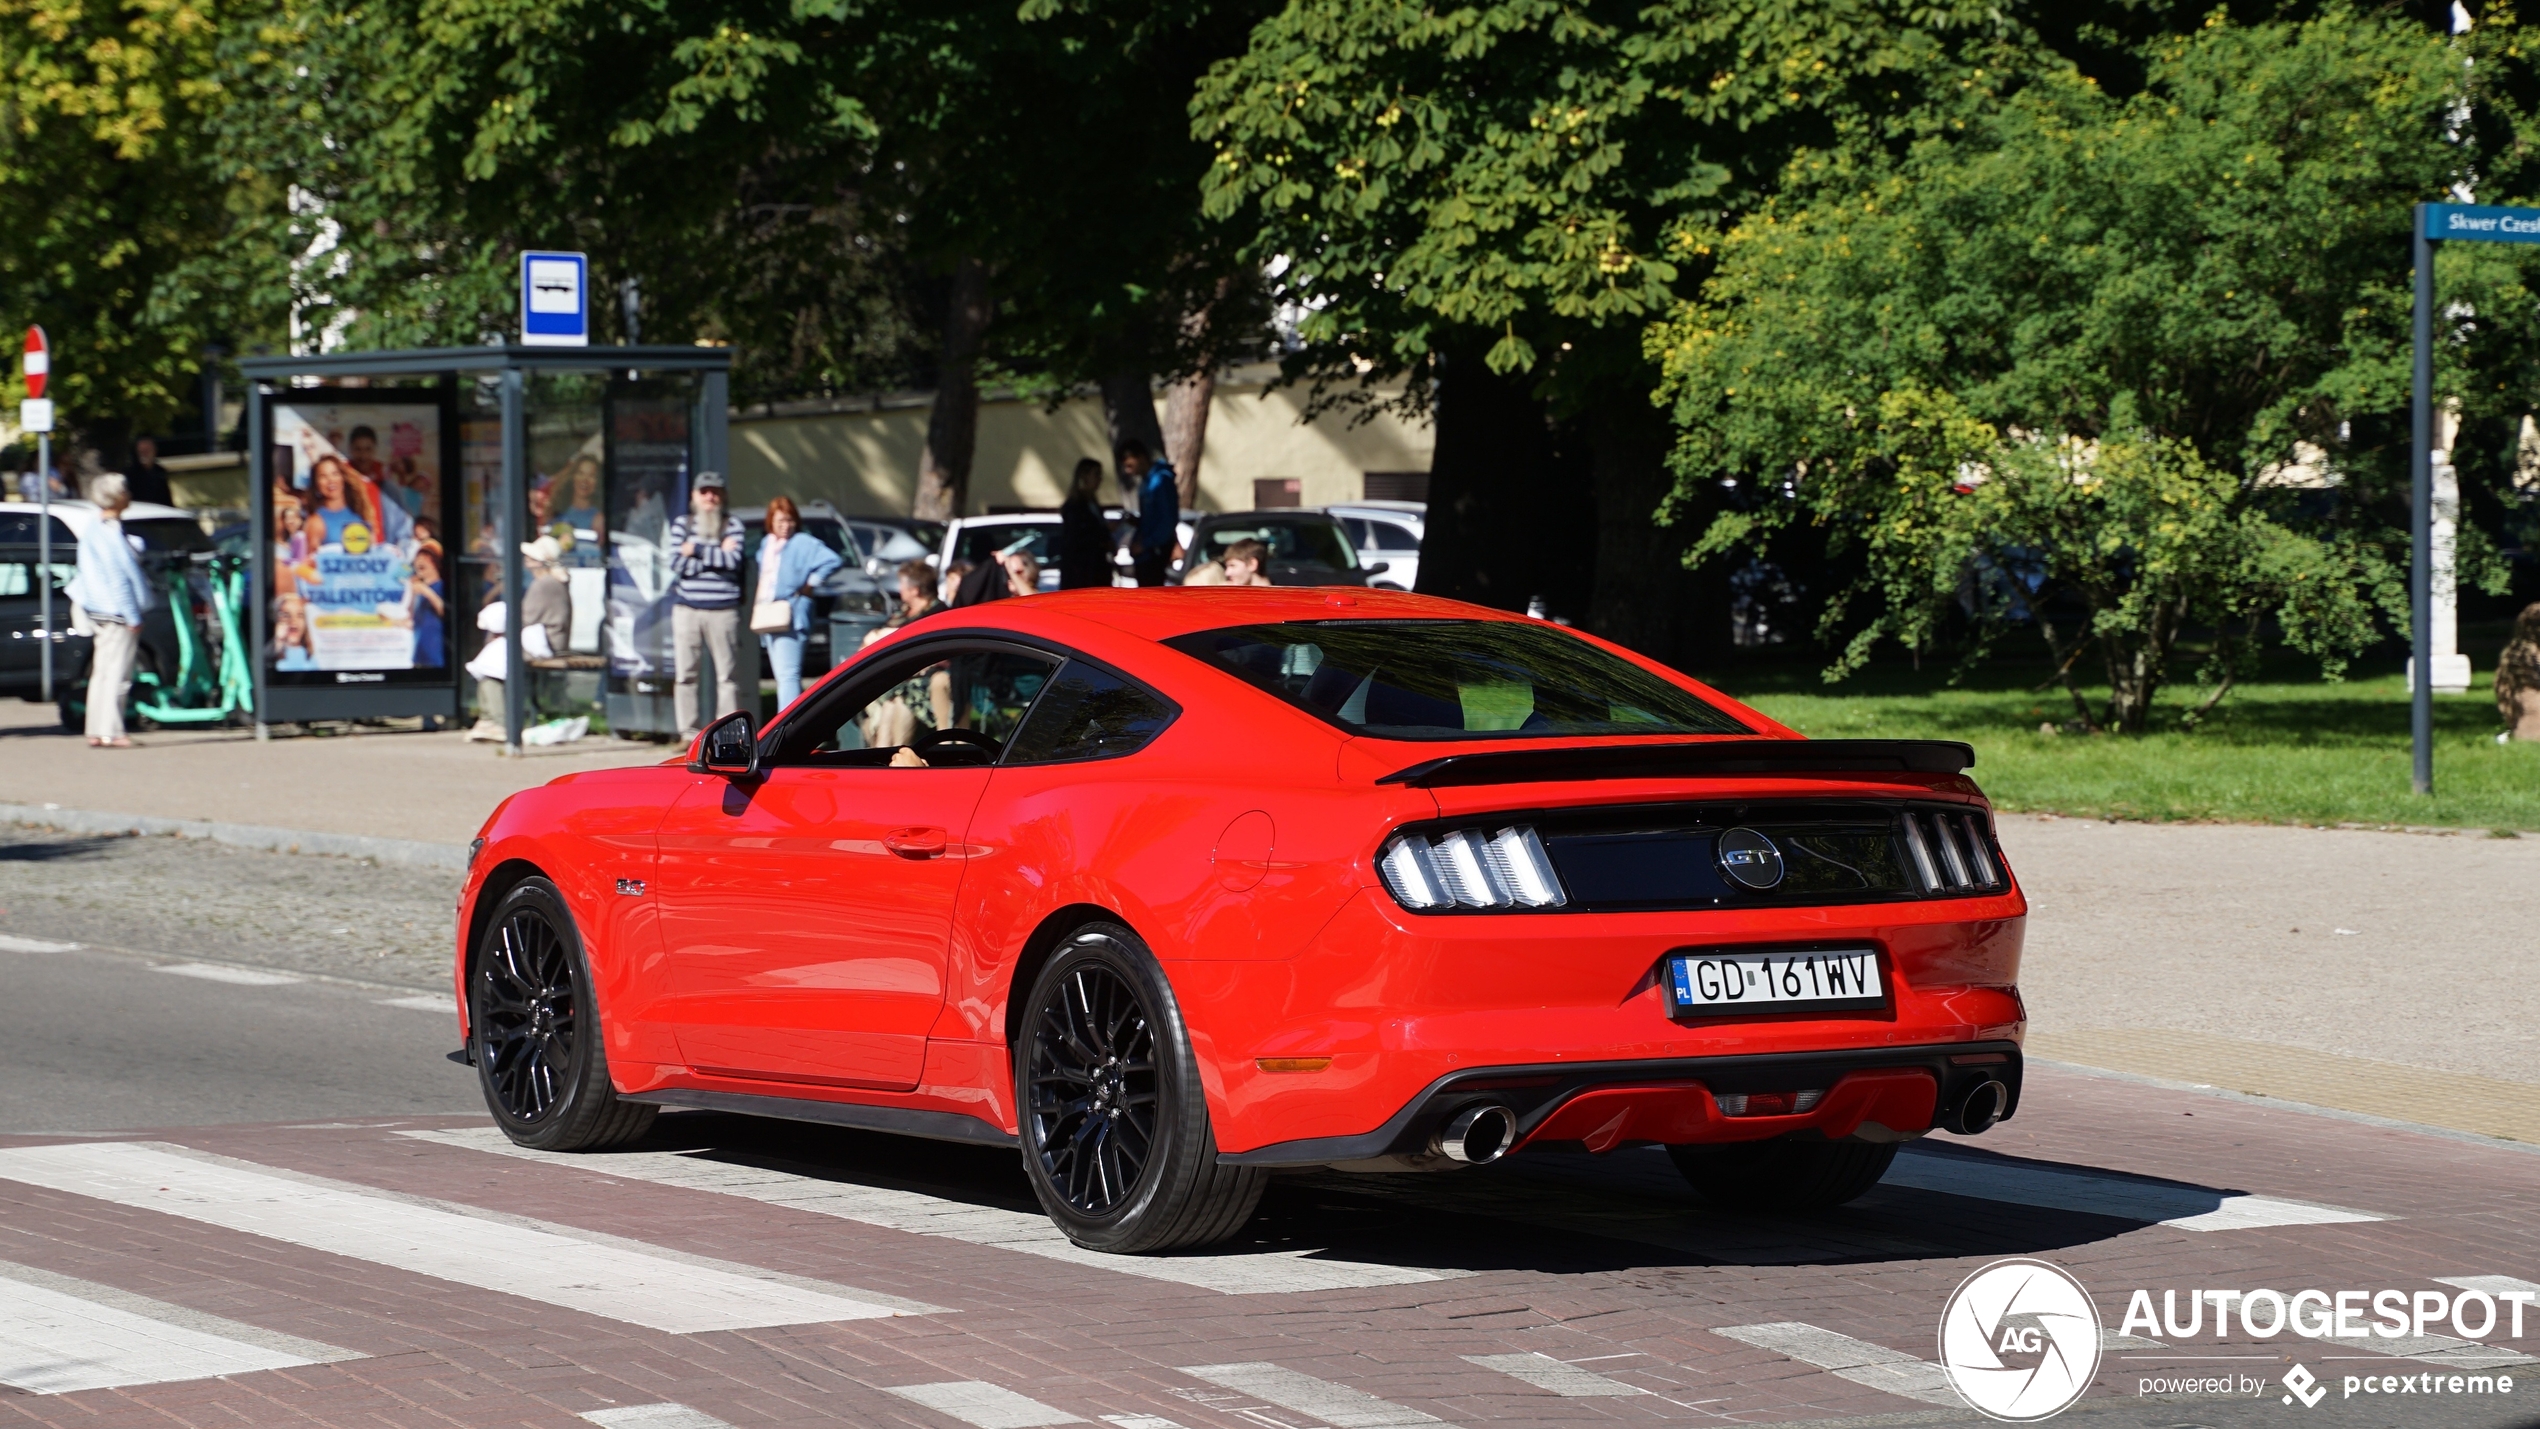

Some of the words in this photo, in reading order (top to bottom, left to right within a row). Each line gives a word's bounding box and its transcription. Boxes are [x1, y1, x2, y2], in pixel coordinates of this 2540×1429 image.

[2449, 213, 2497, 231] Skwer
[1726, 850, 1772, 865] GT
[1697, 960, 1744, 1000] GD
[1762, 954, 1866, 998] 161WV
[1676, 987, 1690, 999] PL
